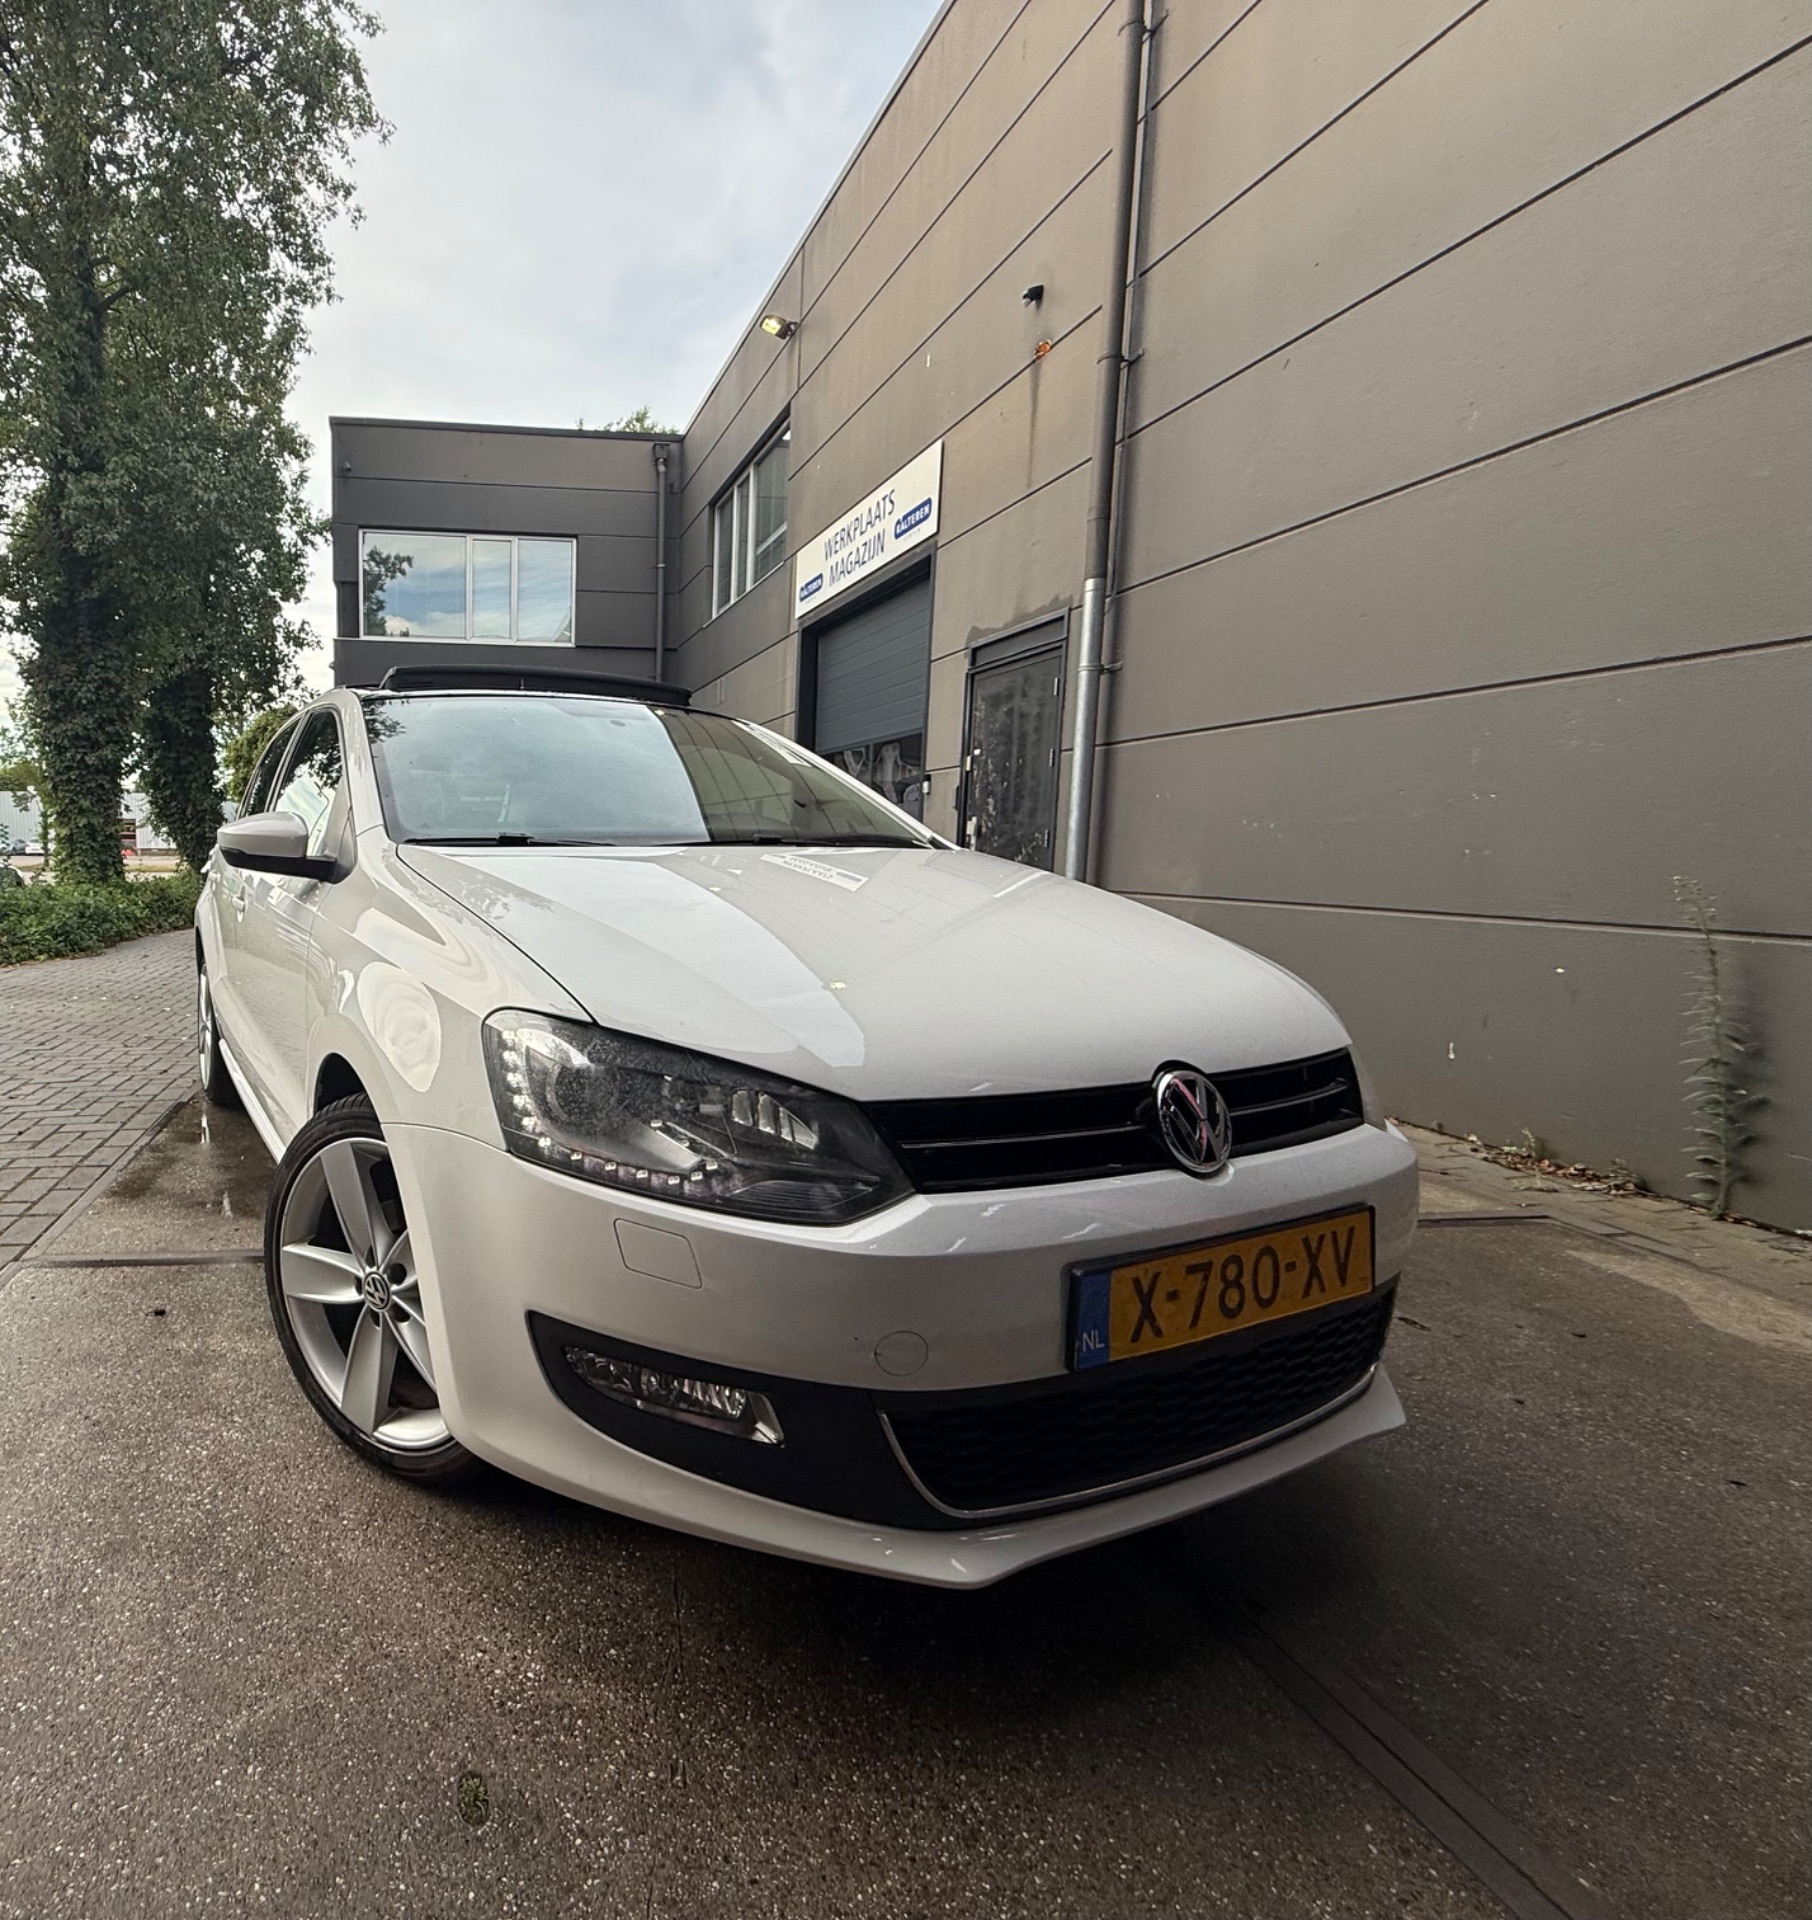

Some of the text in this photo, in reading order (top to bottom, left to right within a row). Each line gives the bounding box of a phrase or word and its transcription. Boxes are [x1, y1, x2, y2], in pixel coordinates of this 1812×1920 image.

[824, 489, 896, 561] WERKPLAATS
[829, 528, 885, 587] MAGAZIJN
[1130, 1225, 1355, 1343] X-780-XV
[1082, 1332, 1106, 1352] NL
